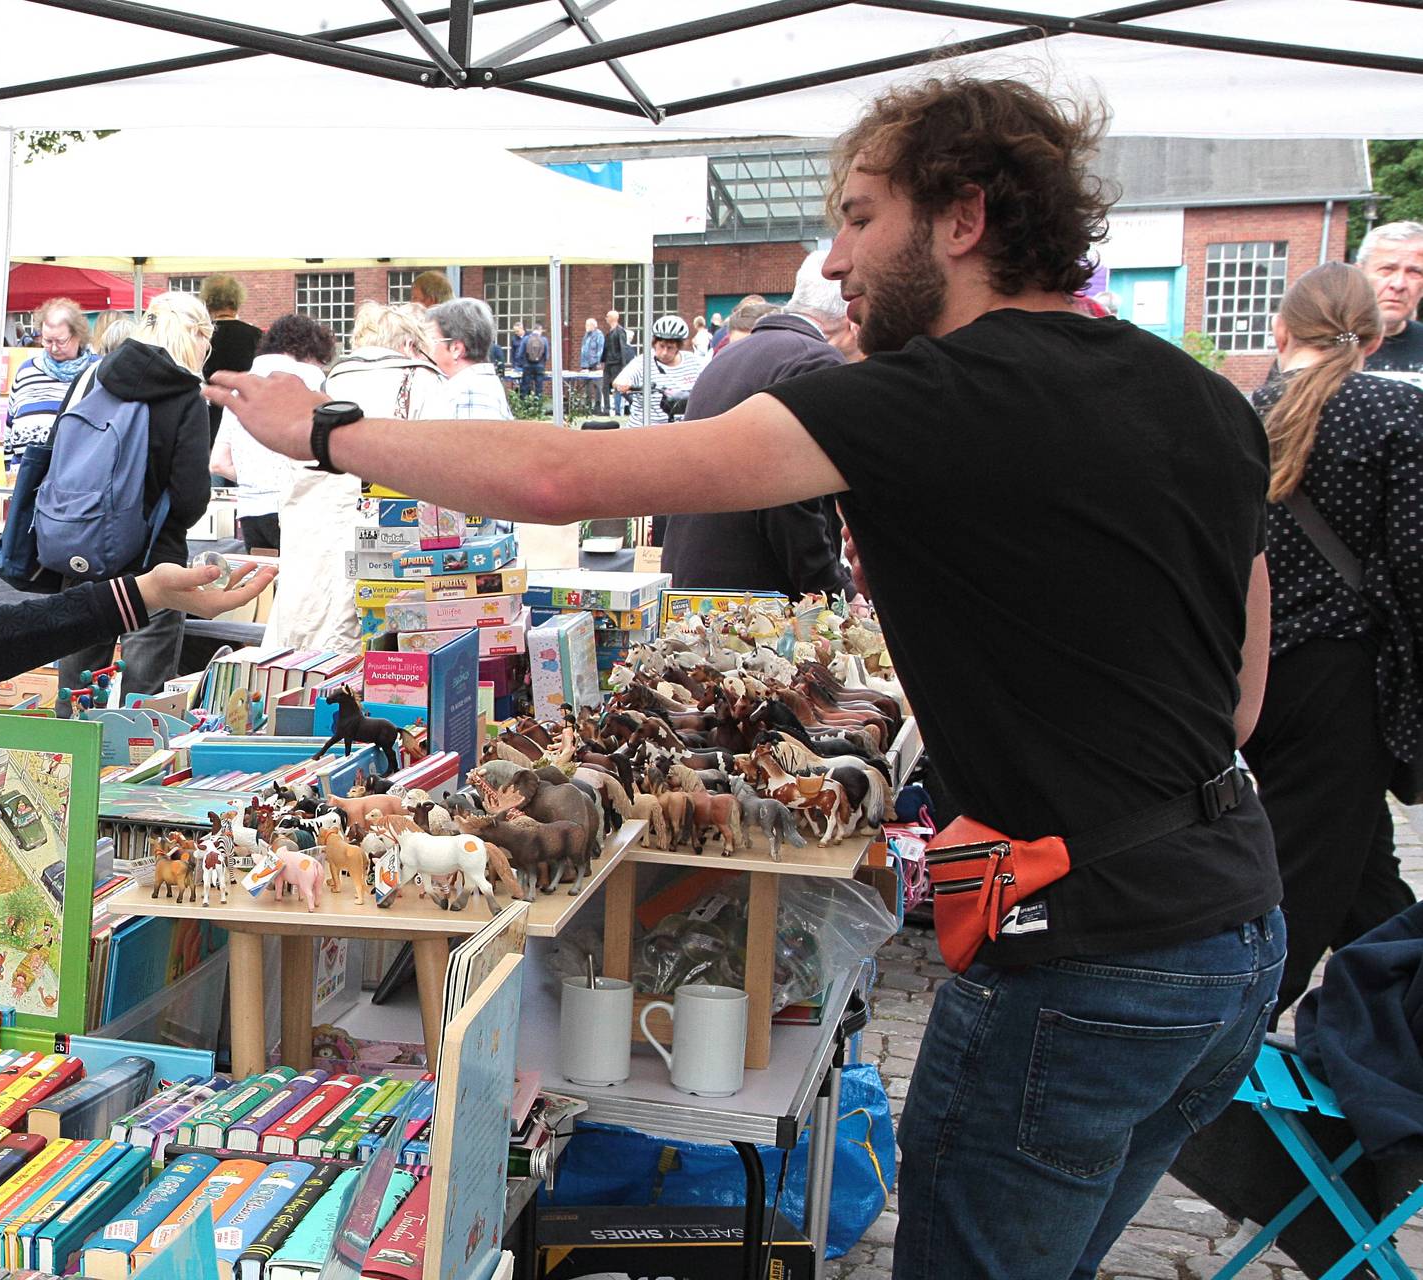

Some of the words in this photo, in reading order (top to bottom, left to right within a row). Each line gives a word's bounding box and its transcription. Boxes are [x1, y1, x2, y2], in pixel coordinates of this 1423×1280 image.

[381, 533, 404, 542] tiptoi
[408, 556, 435, 566] PUZZLES
[442, 579, 469, 591] PUZZLES
[436, 608, 462, 617] Lillifee
[371, 671, 420, 681] Anziehpuppe
[590, 1228, 665, 1241] SHOES
[668, 1227, 747, 1240] SAFETY
